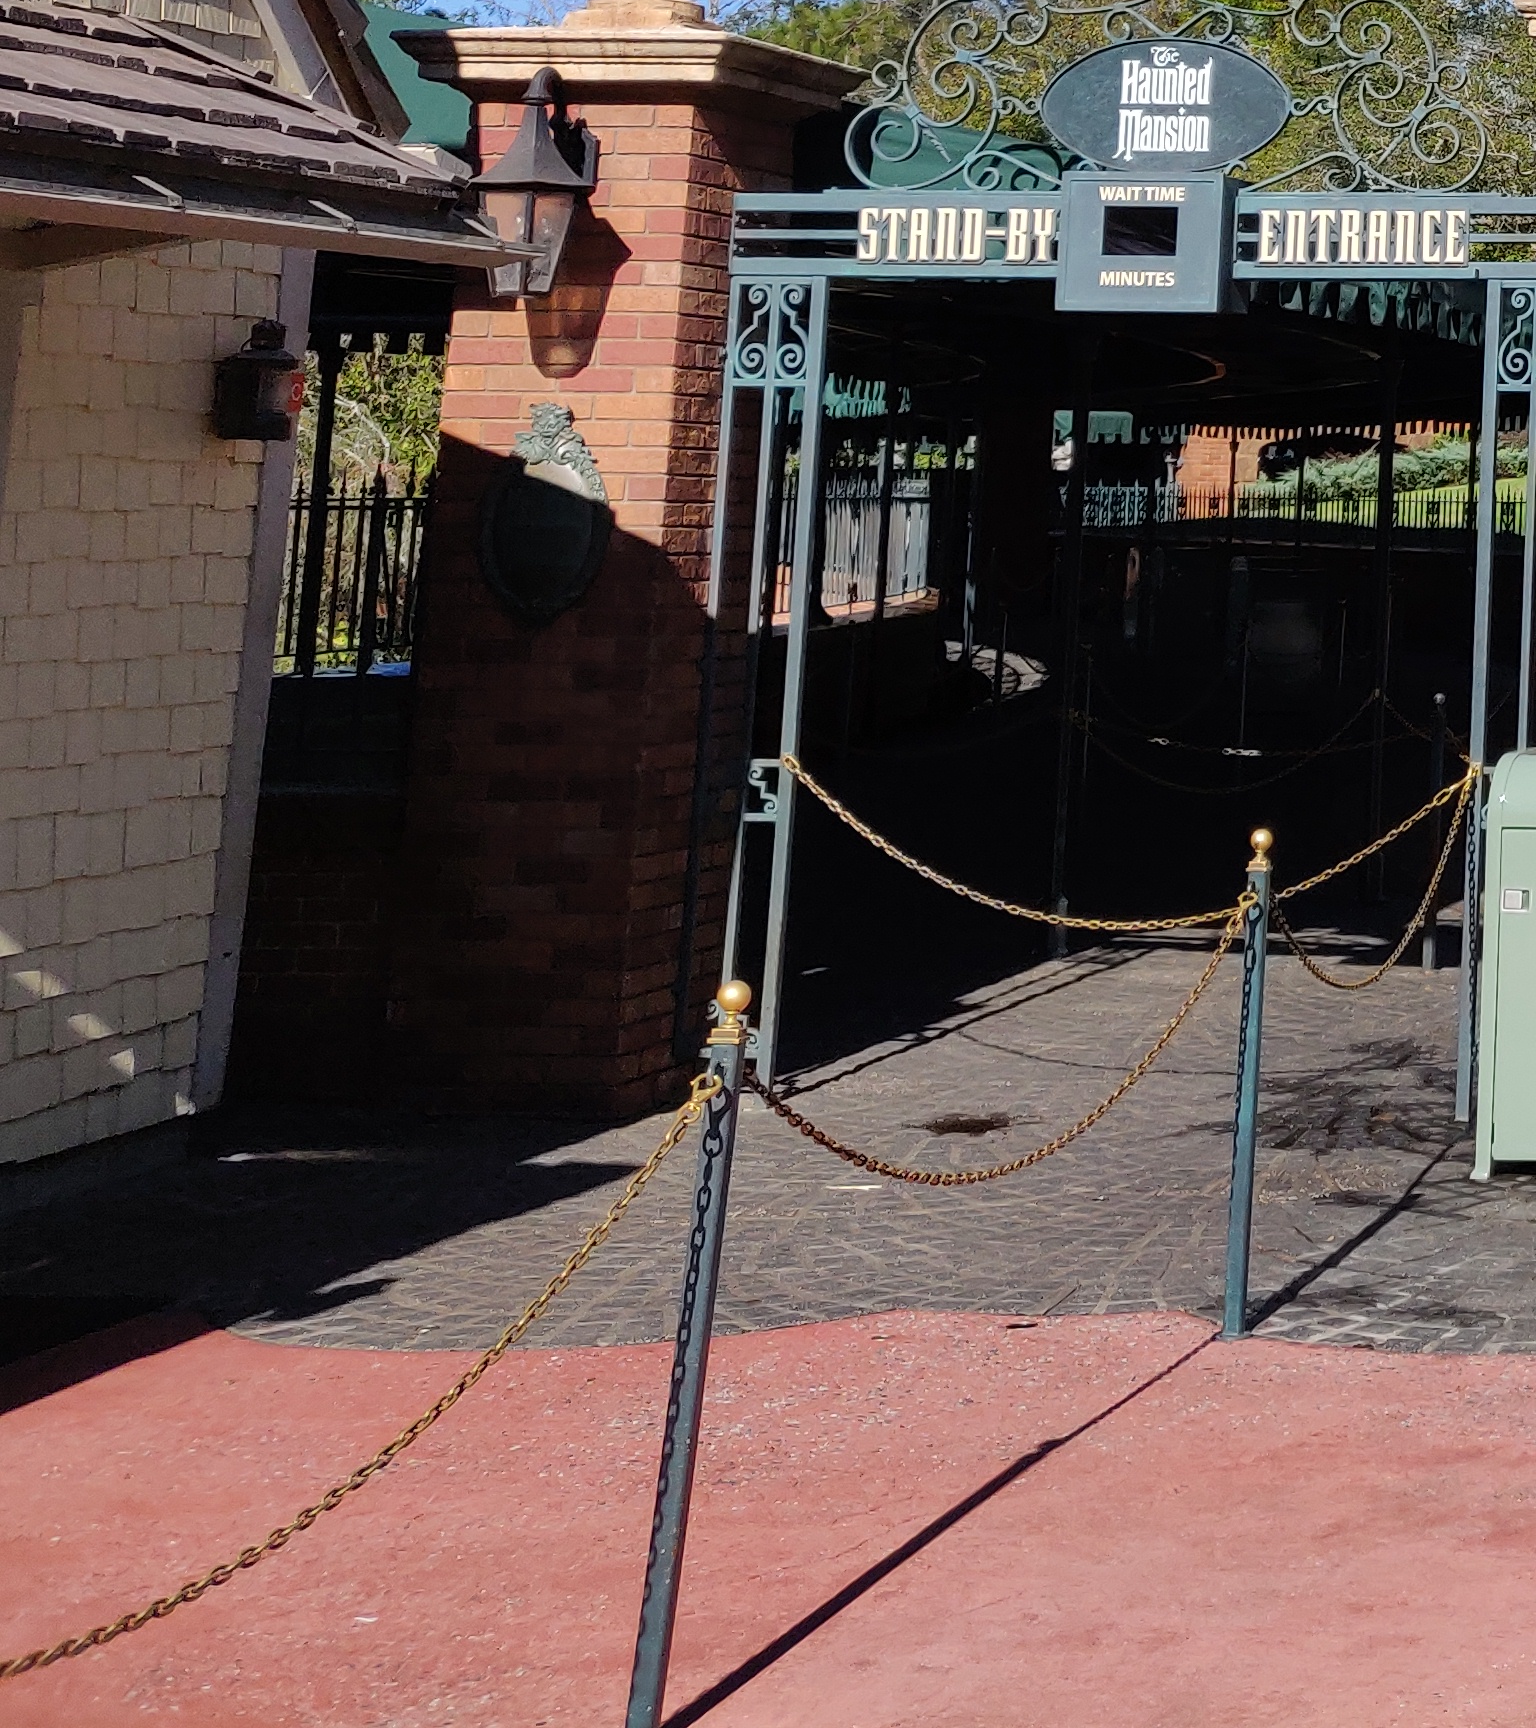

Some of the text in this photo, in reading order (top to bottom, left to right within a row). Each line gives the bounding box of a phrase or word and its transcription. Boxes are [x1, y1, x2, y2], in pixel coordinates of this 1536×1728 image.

[1151, 47, 1180, 66] The
[1120, 56, 1213, 105] Haunted
[1111, 107, 1210, 162] Mansion
[1099, 186, 1185, 202] WAIT TIME
[858, 207, 1467, 264] STAND-BY ENTRANCE
[1099, 271, 1175, 287] MINUTES
